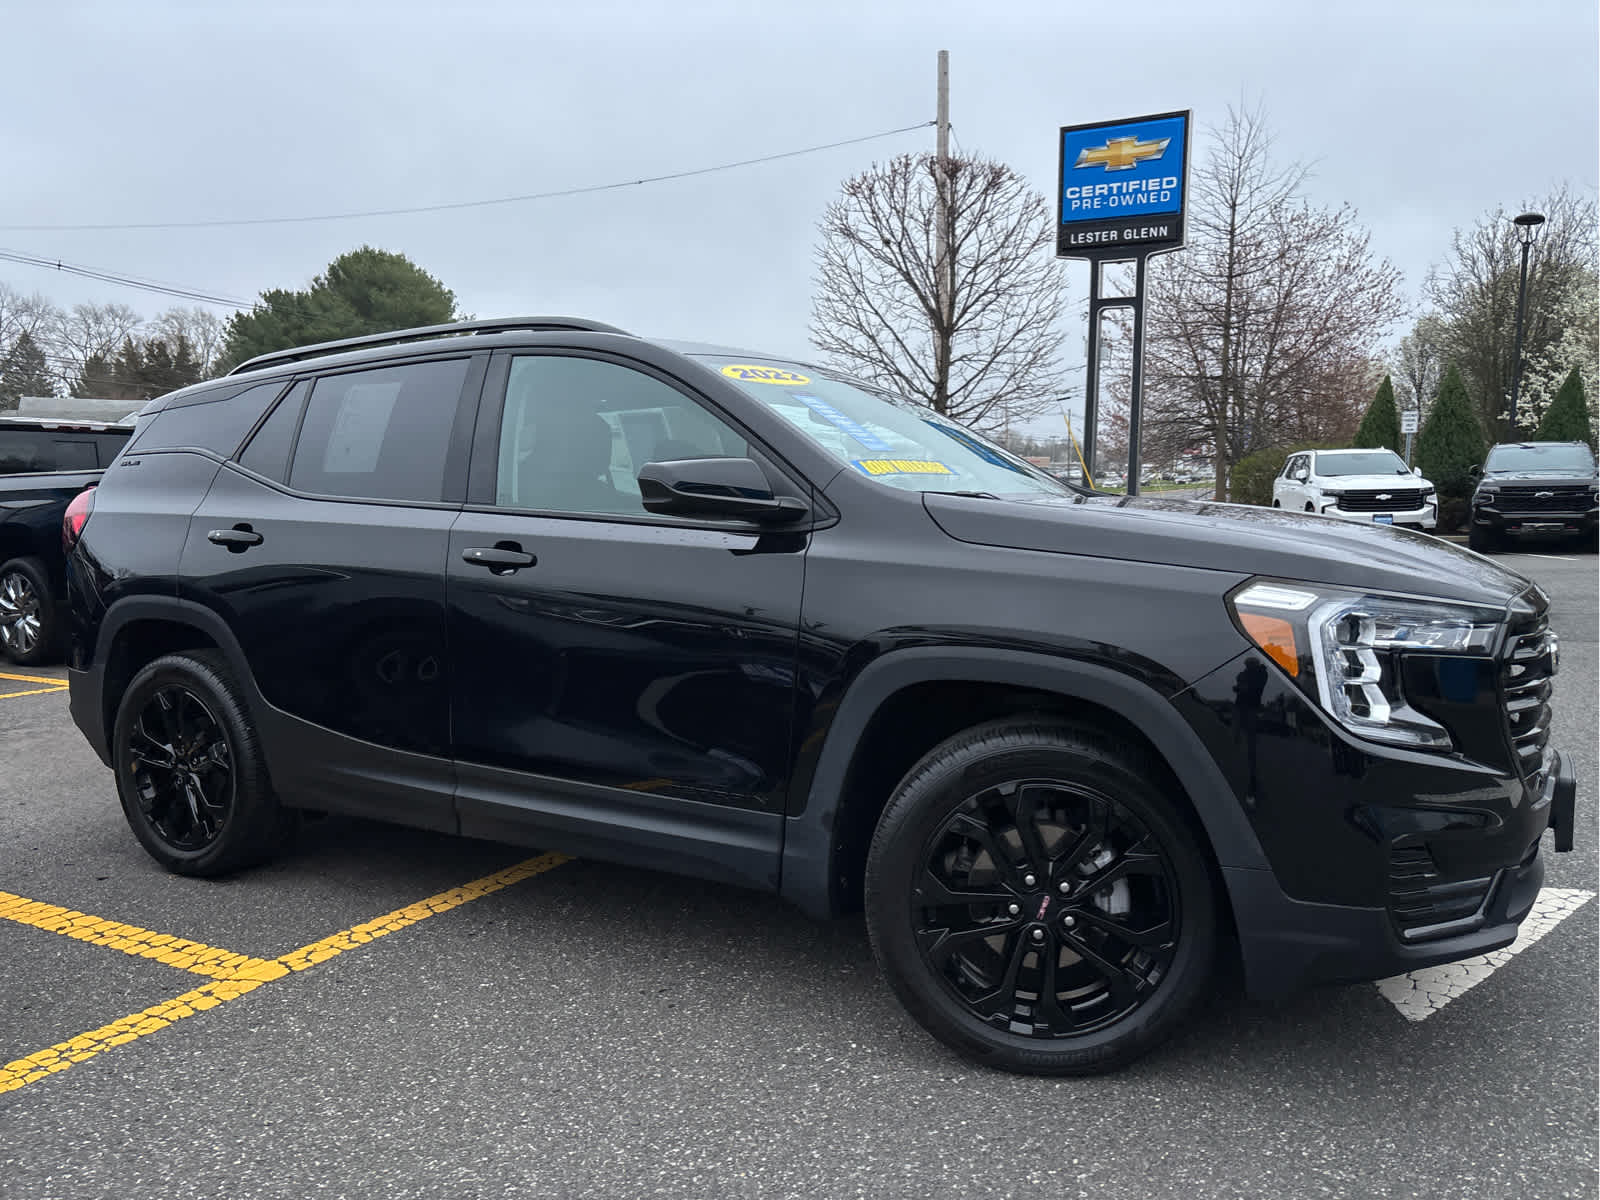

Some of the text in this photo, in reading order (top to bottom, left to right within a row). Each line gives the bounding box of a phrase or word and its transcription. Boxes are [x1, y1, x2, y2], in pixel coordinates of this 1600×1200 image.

[1066, 176, 1177, 199] CERTIFIED
[1071, 190, 1170, 211] PRE-OWNED
[1070, 226, 1168, 244] LESTER GLENN
[731, 367, 807, 382] 2022
